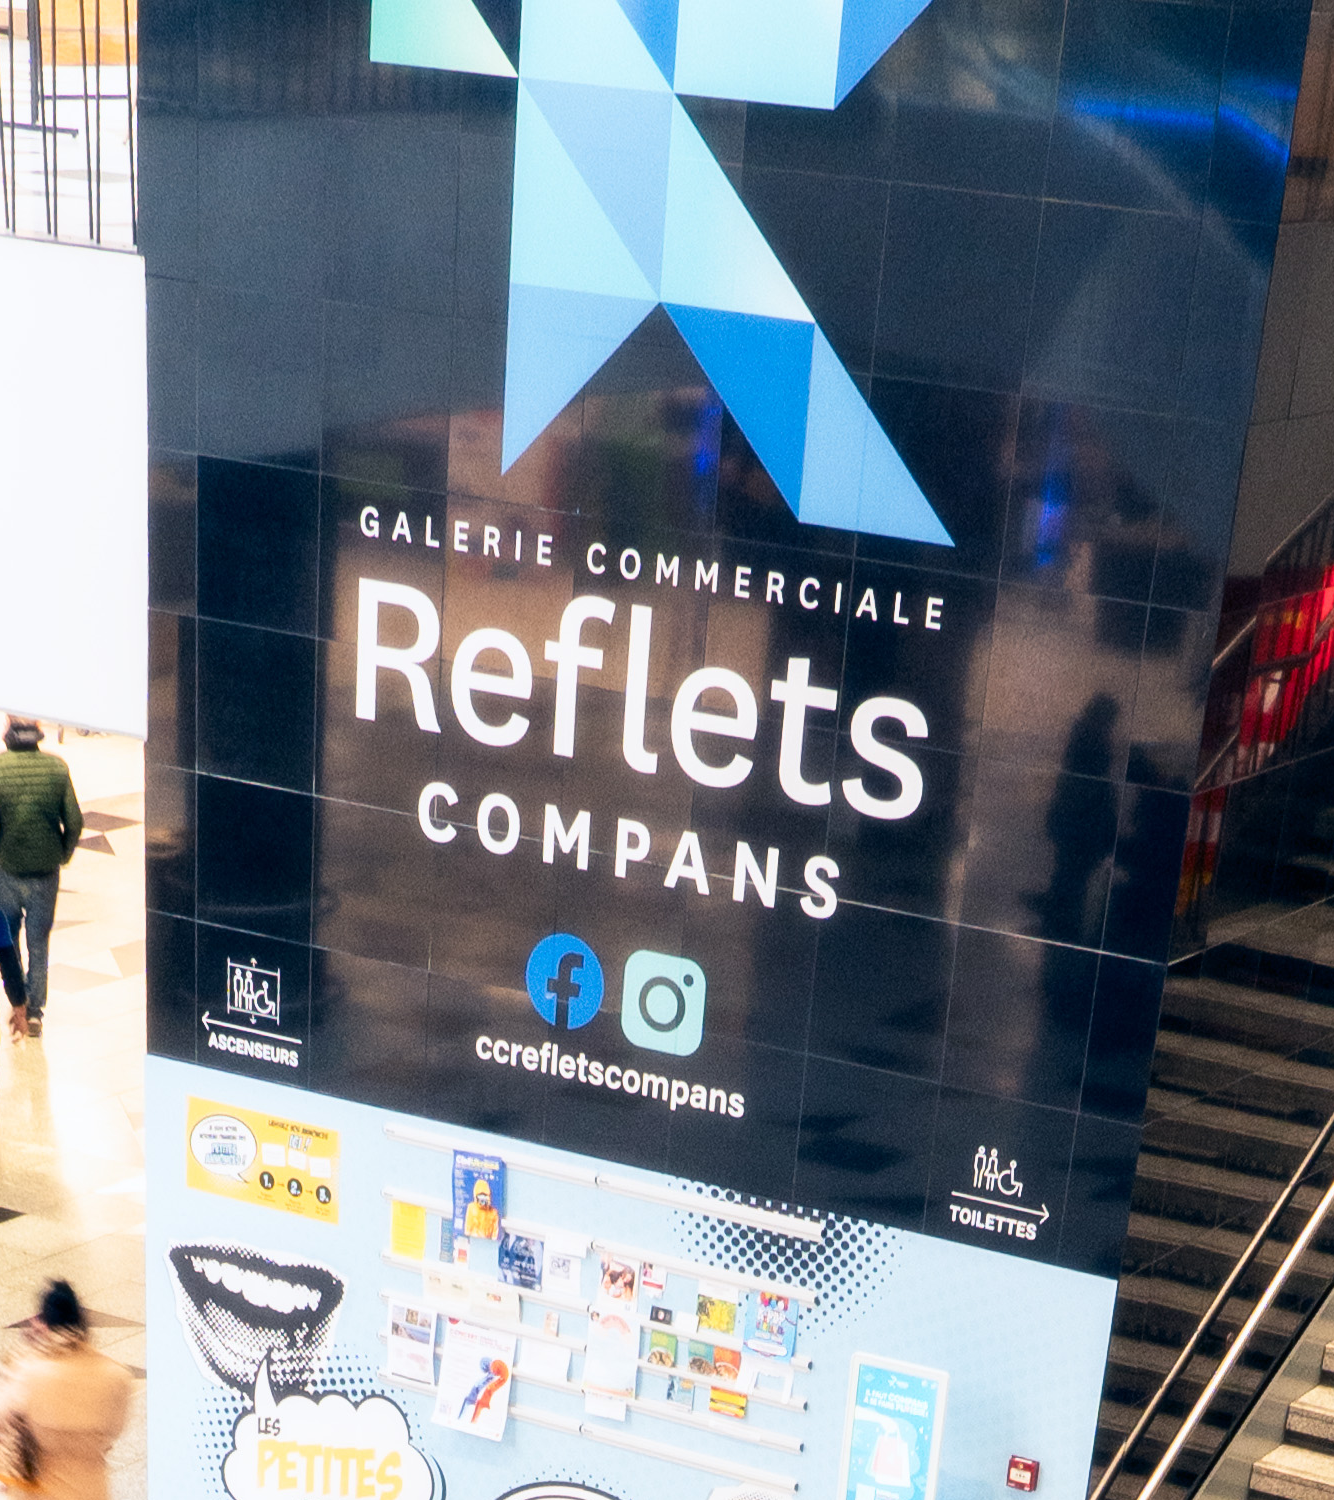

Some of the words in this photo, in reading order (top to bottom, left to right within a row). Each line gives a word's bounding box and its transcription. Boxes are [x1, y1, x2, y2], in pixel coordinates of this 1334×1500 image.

[360, 506, 555, 568] GALERIE
[586, 543, 946, 631] COMMERCIALE
[354, 576, 930, 821] Reflets
[418, 781, 842, 921] COMPANS
[206, 1031, 301, 1068] ASCENSEURS
[474, 1031, 746, 1119] ccrefletscompans
[948, 1202, 1037, 1240] TOILETTES
[257, 1415, 282, 1440] LES
